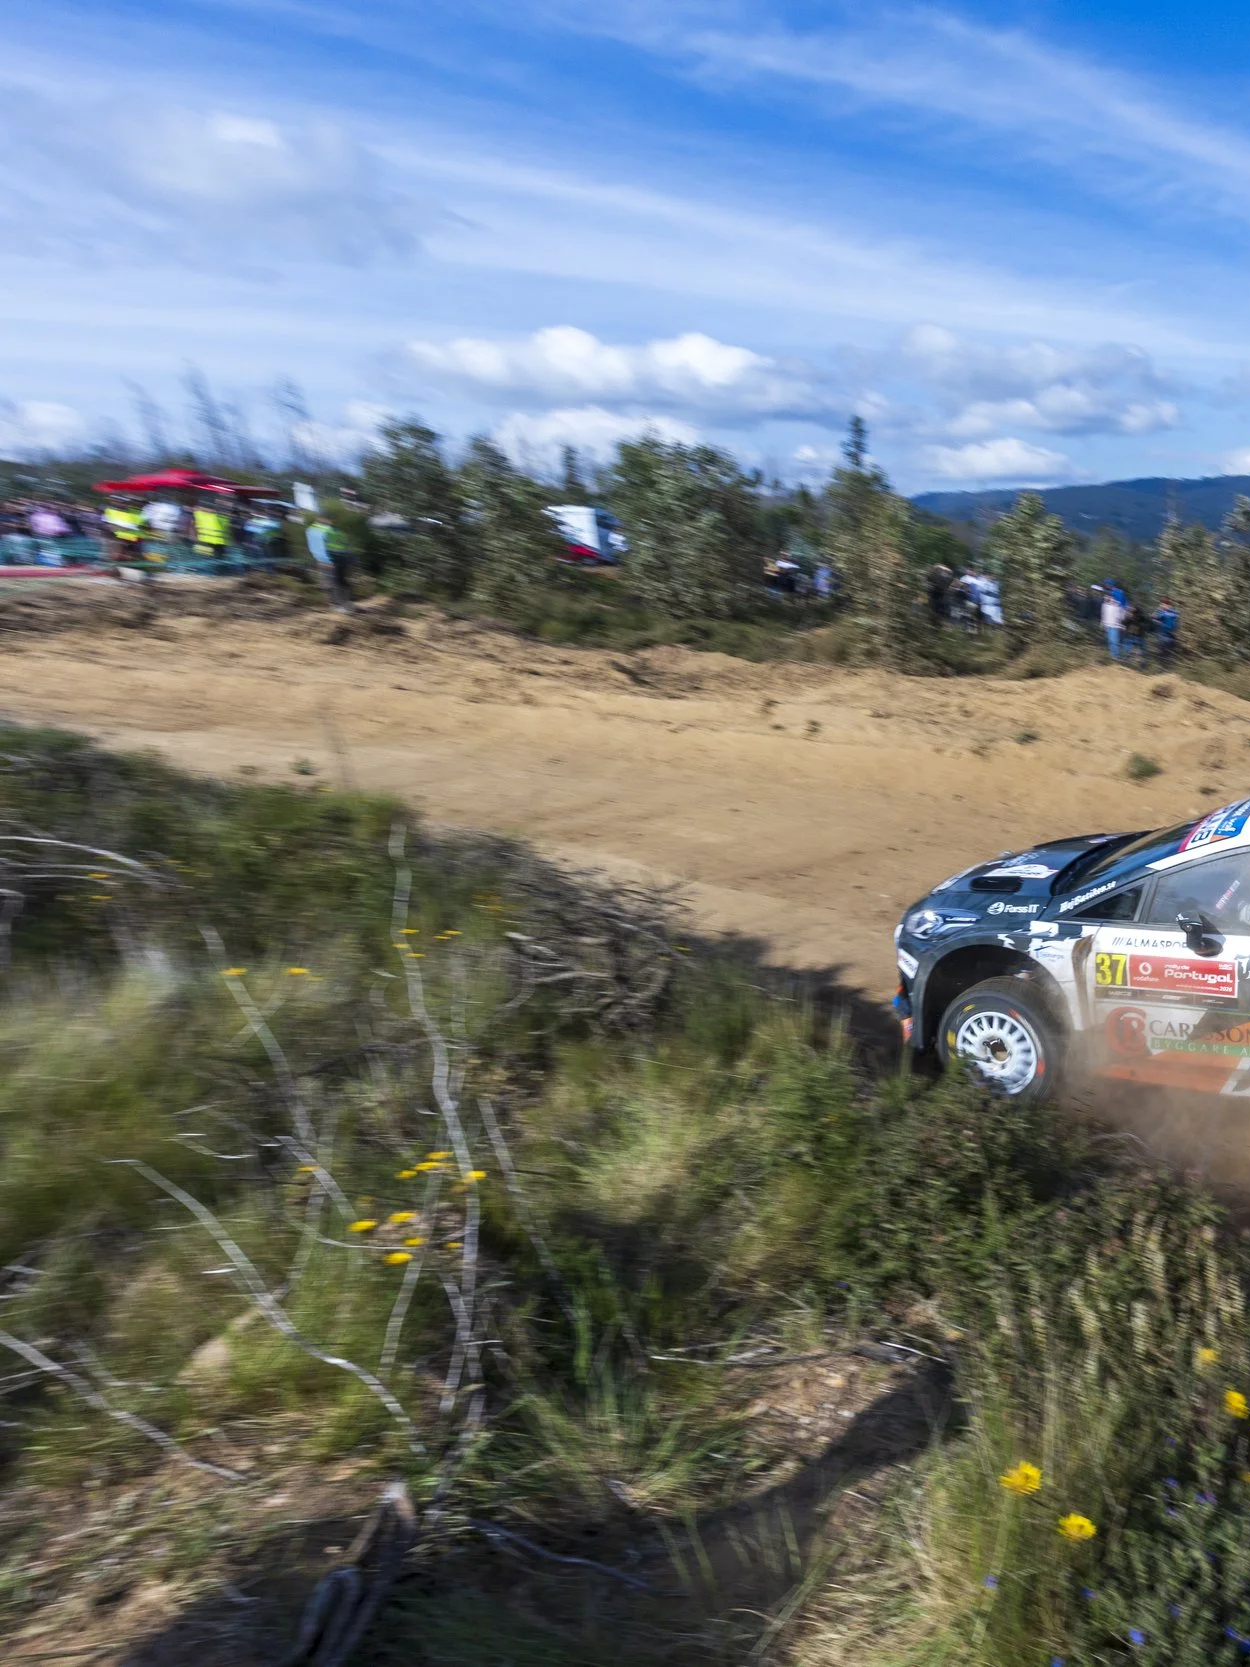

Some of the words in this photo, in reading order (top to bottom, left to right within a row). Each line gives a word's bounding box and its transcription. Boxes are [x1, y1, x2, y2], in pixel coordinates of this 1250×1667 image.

[1126, 937, 1187, 948] ALMASPOR
[1096, 953, 1127, 985] 37
[1165, 969, 1234, 984] Portugal
[1153, 1040, 1230, 1055] BYGGARE
